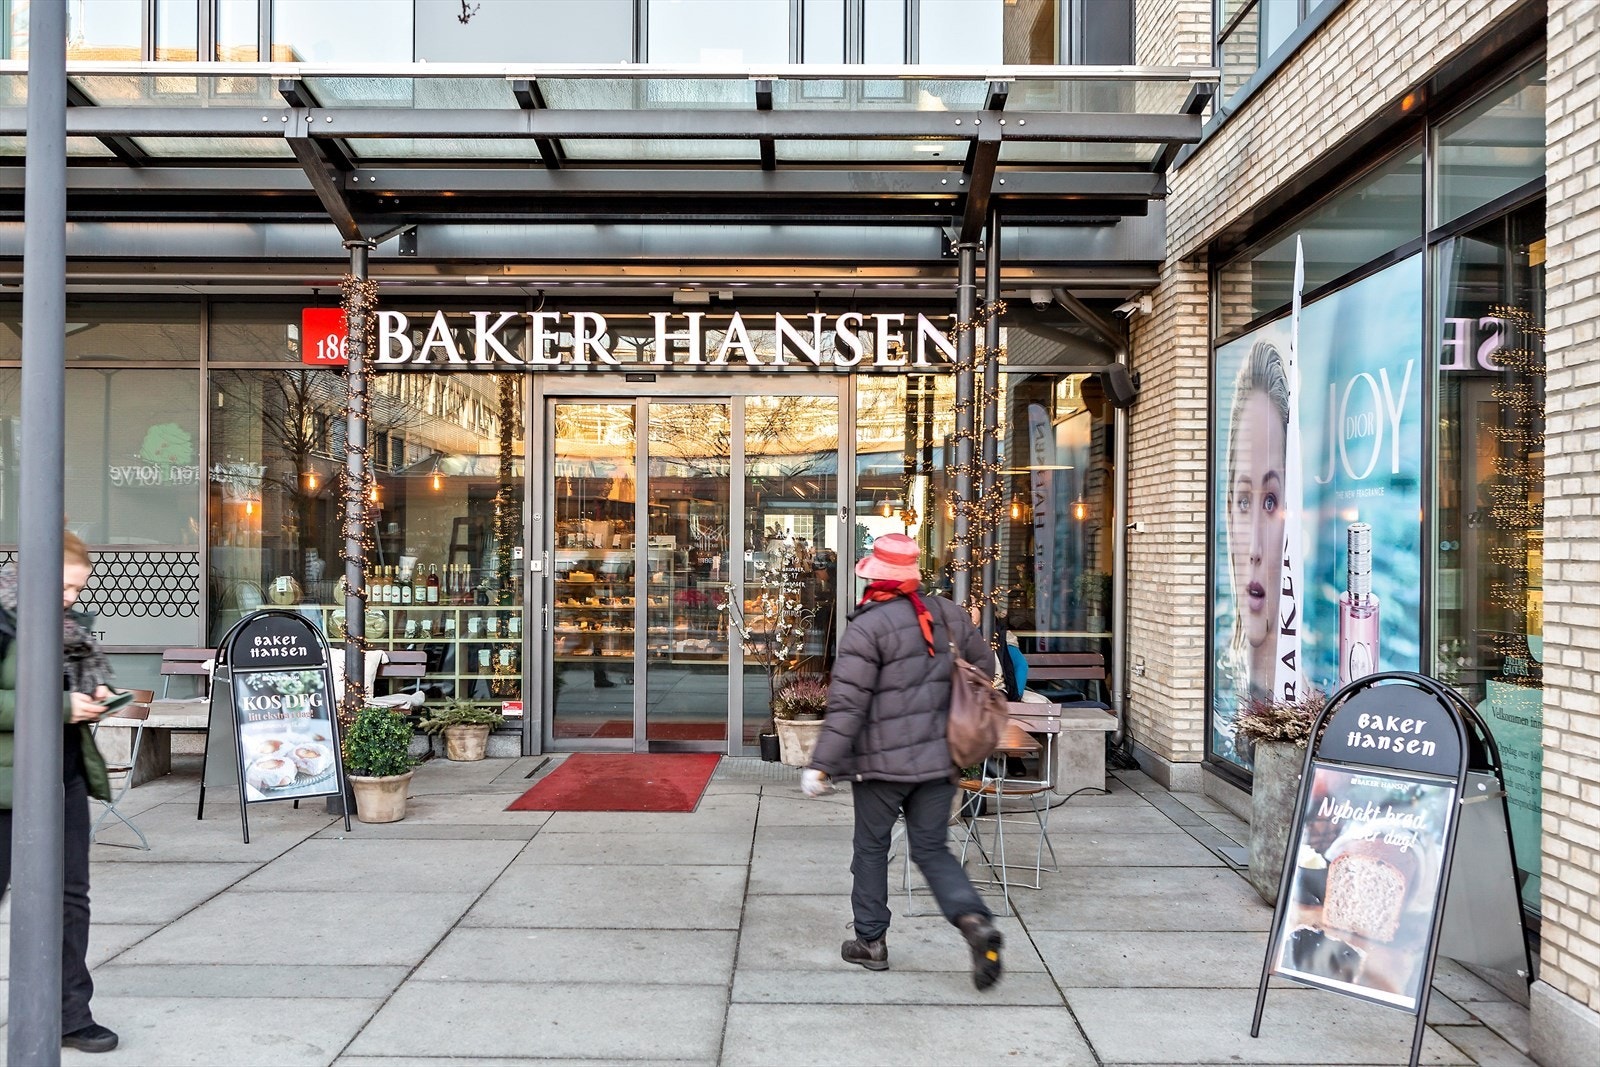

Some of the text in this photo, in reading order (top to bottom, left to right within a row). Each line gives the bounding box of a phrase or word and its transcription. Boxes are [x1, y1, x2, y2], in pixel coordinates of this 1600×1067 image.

[317, 334, 348, 360] 186
[374, 310, 958, 366] BAKER HANSEN
[1314, 359, 1414, 484] JOY
[1346, 411, 1374, 440] DIOR
[1357, 487, 1385, 497] FRAGRANCE
[242, 695, 282, 711] KOS
[1357, 778, 1410, 792] BAKER HANSEN
[1318, 796, 1382, 824] Nybakt
[1384, 829, 1418, 854] dag!
